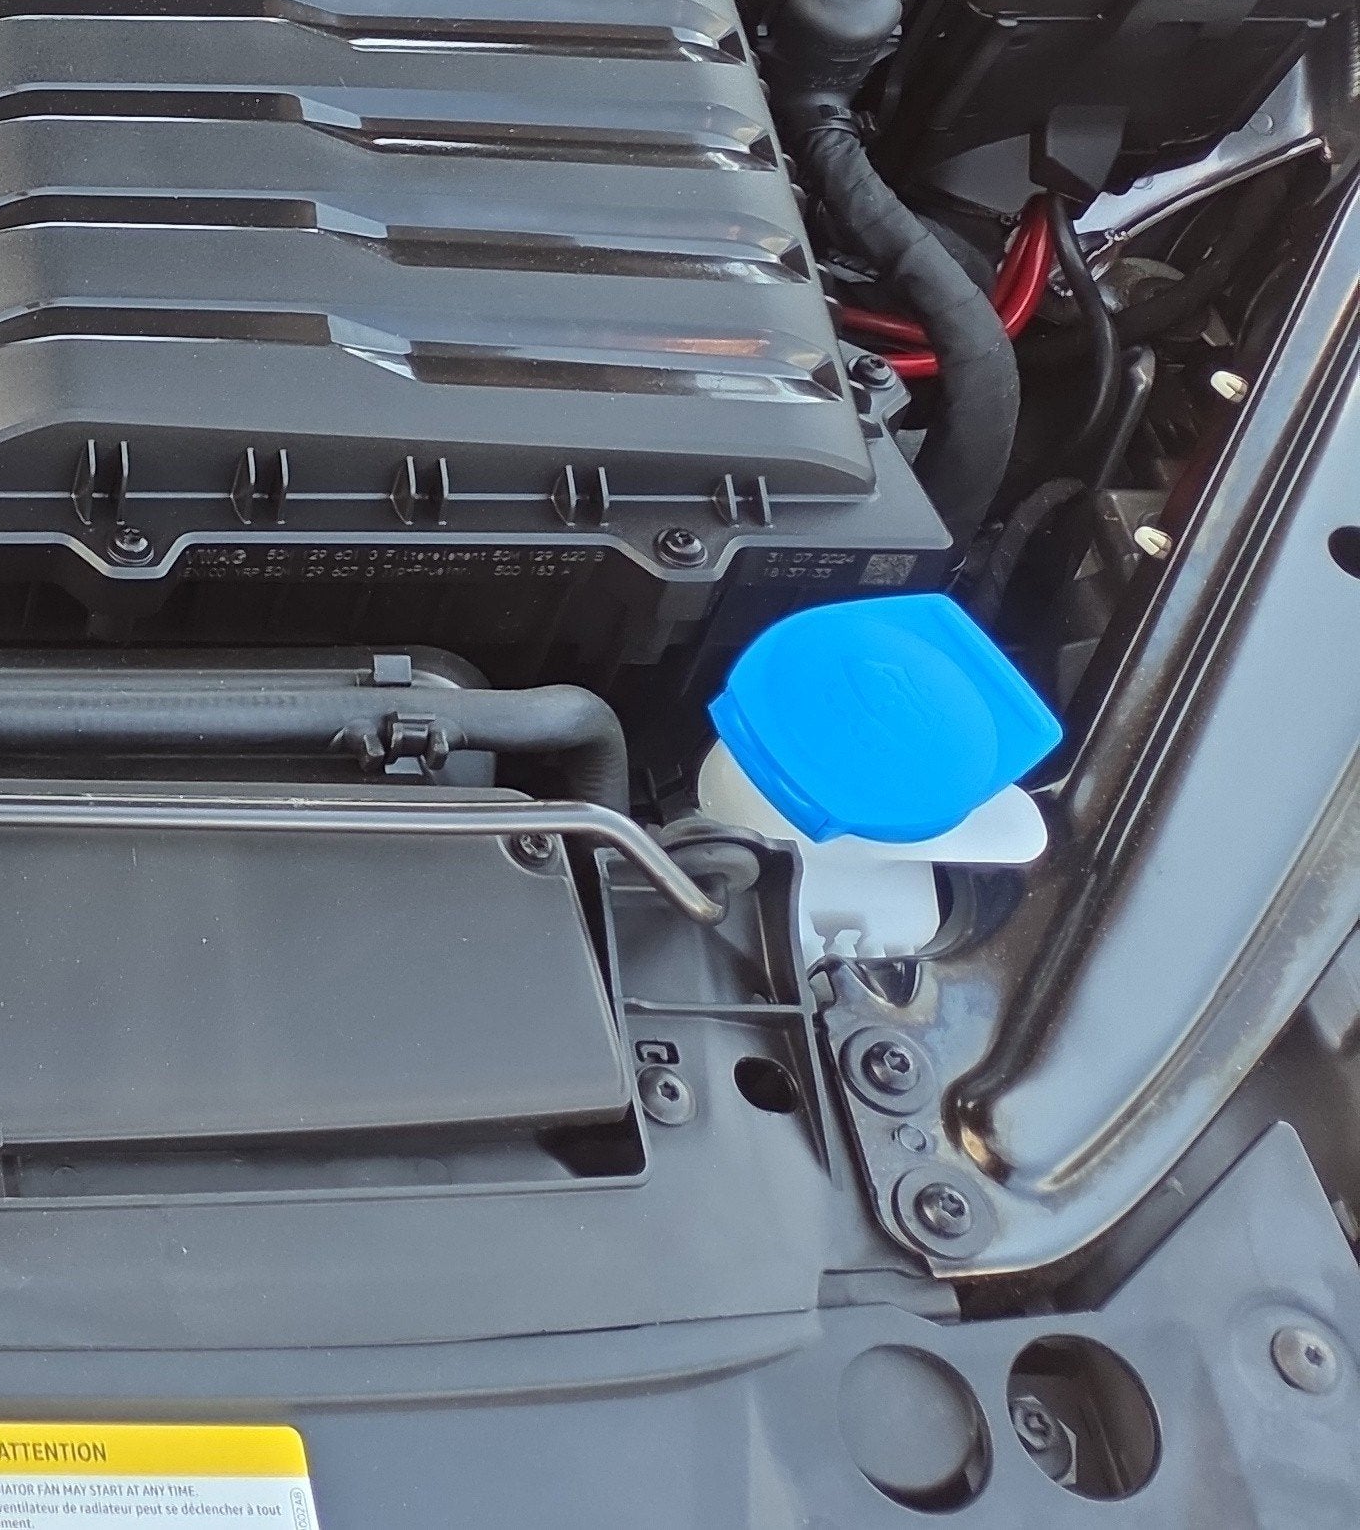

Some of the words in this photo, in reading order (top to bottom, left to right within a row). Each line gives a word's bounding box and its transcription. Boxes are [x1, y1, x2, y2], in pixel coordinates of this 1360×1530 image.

[38, 1483, 61, 1496] FAN
[63, 1483, 87, 1497] MAY
[88, 1484, 124, 1498] START
[126, 1484, 141, 1497] AT
[142, 1484, 164, 1497] ANY
[165, 1485, 199, 1498] TIME.
[62, 1502, 78, 1515] de
[80, 1502, 132, 1516] radiateur
[135, 1504, 162, 1519] peut
[165, 1506, 179, 1516] se
[181, 1502, 243, 1517] déclencher
[246, 1503, 255, 1516] à
[256, 1504, 282, 1516] tout
